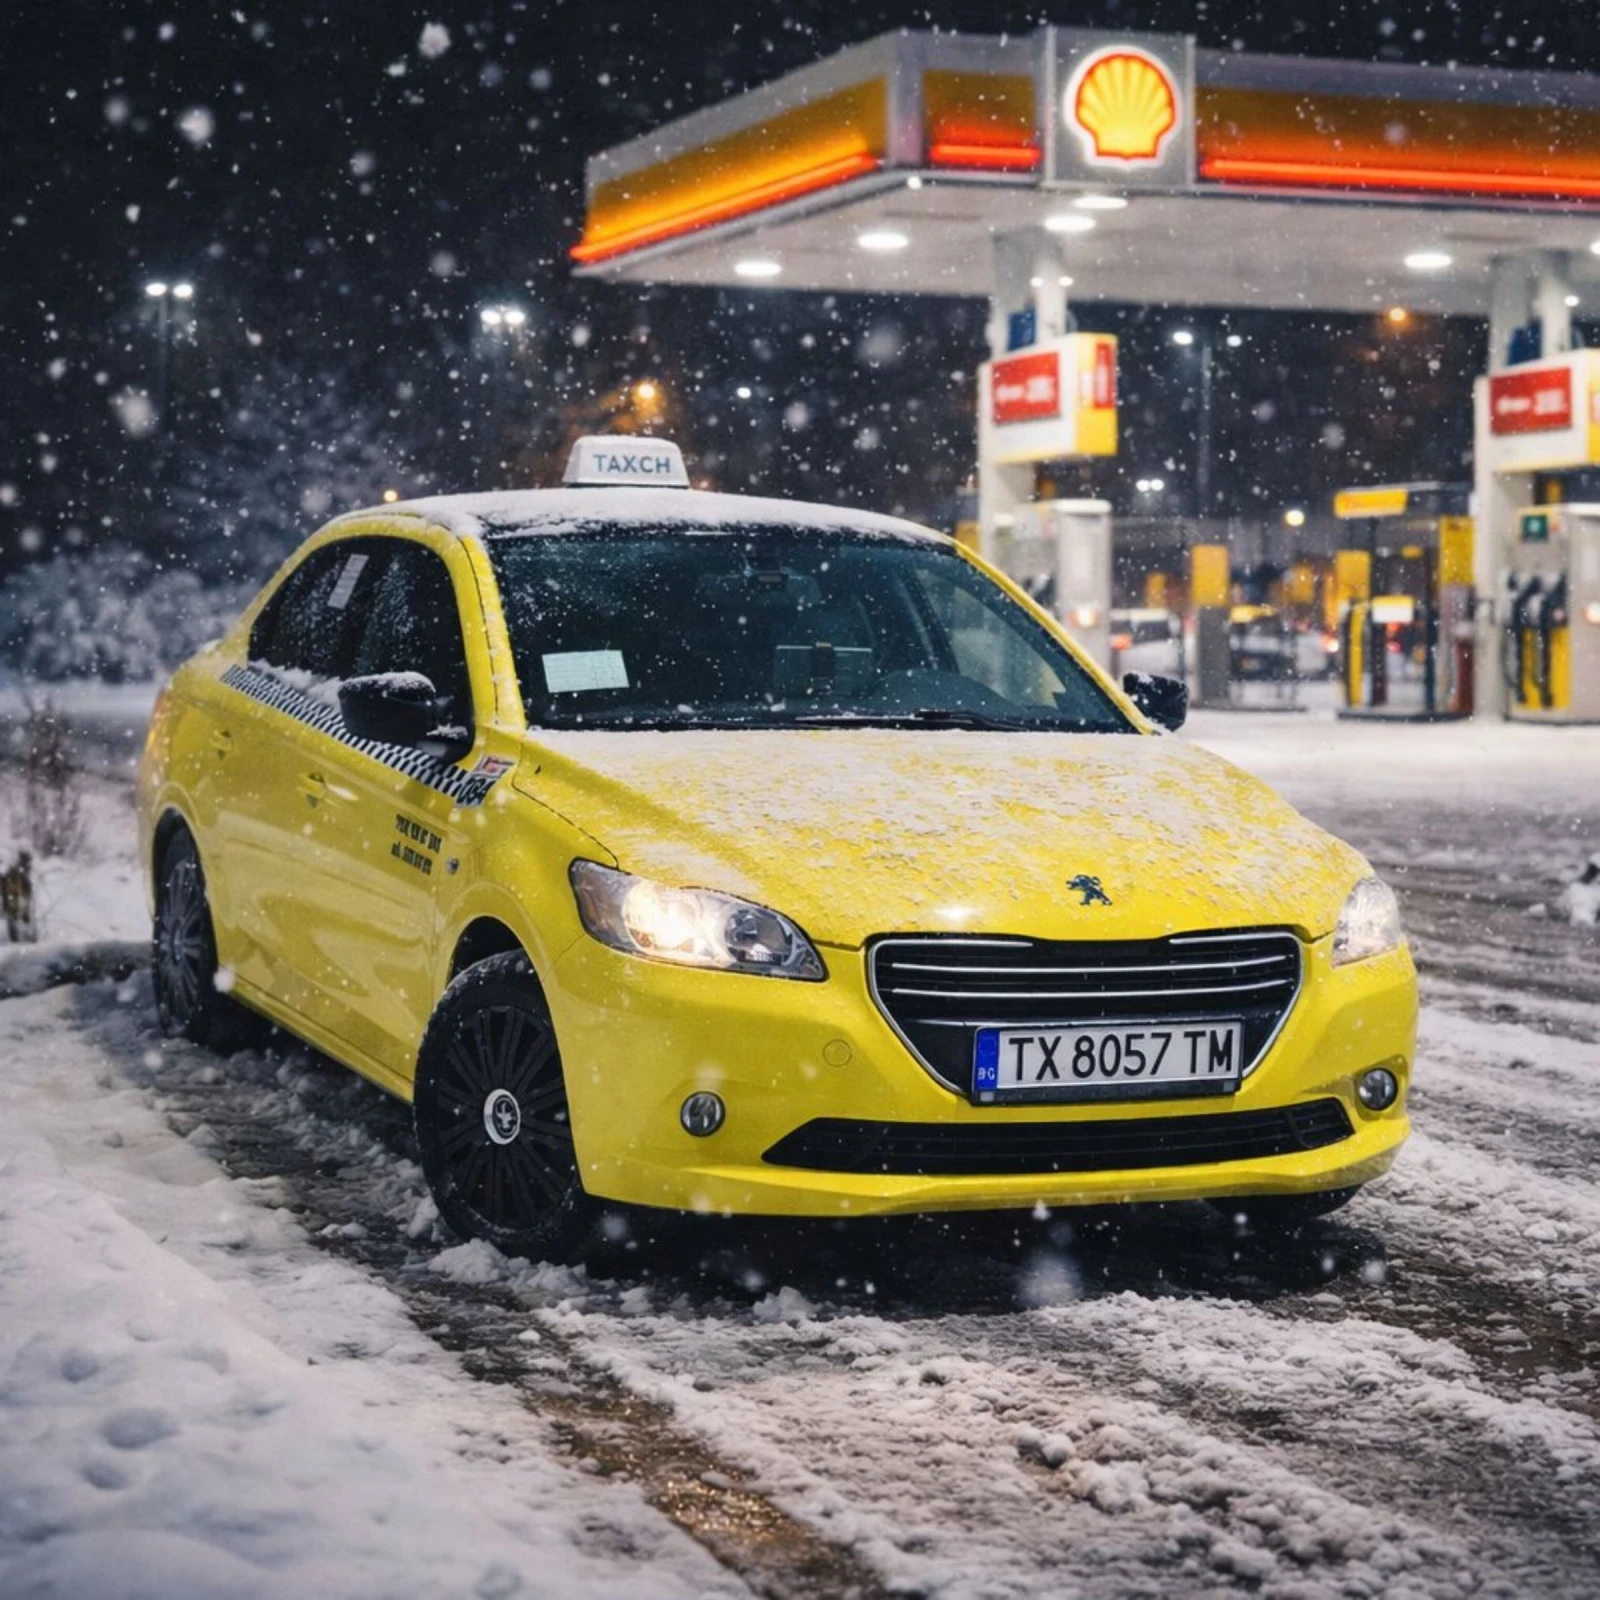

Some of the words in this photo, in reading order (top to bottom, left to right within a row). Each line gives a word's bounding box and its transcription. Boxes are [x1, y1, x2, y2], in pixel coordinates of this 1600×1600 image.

[593, 454, 671, 473] TAXCH
[1009, 1036, 1061, 1081] TX
[1071, 1033, 1172, 1079] 8057
[1183, 1029, 1234, 1075] TM
[978, 1067, 995, 1081] BG
